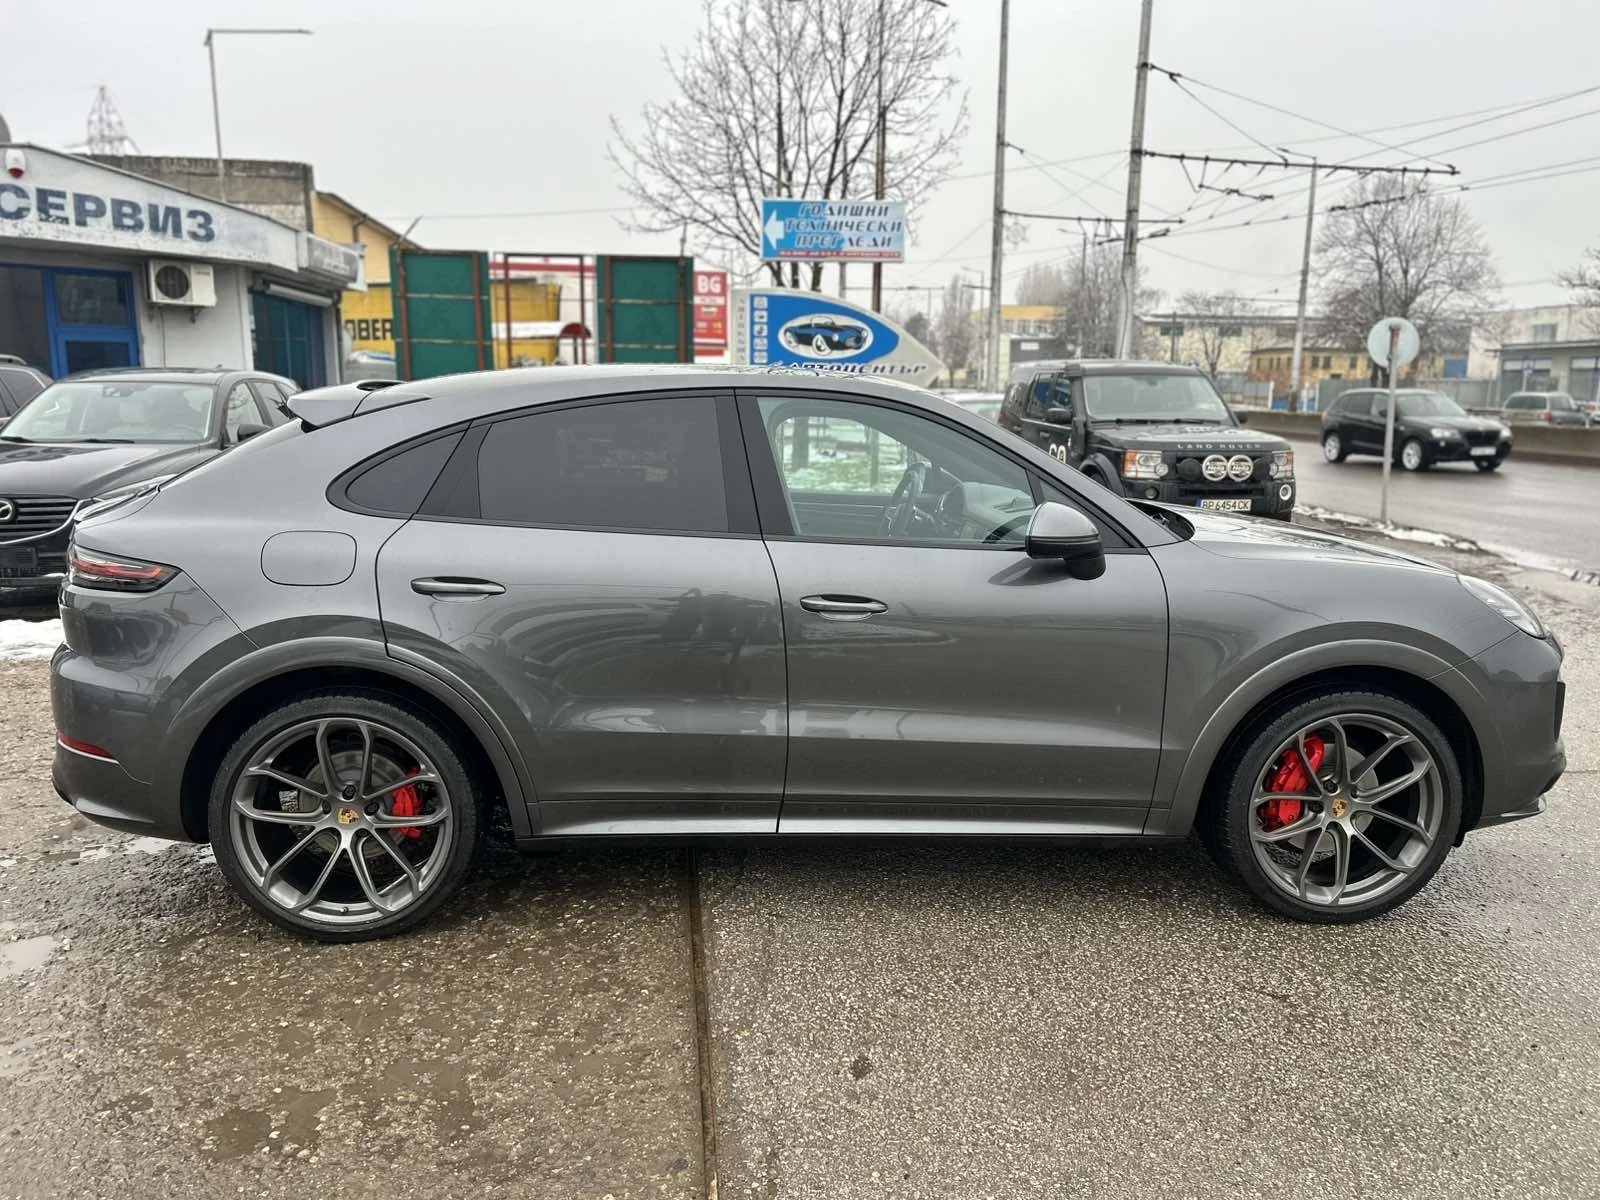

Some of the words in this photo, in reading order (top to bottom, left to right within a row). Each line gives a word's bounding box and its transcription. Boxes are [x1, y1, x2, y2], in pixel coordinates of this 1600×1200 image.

[0, 183, 216, 243] СЕРВИЗ
[799, 204, 889, 217] ГОДИШНИ
[786, 219, 902, 233] ТЕХНИЧЕСКИ
[697, 275, 721, 294] BG
